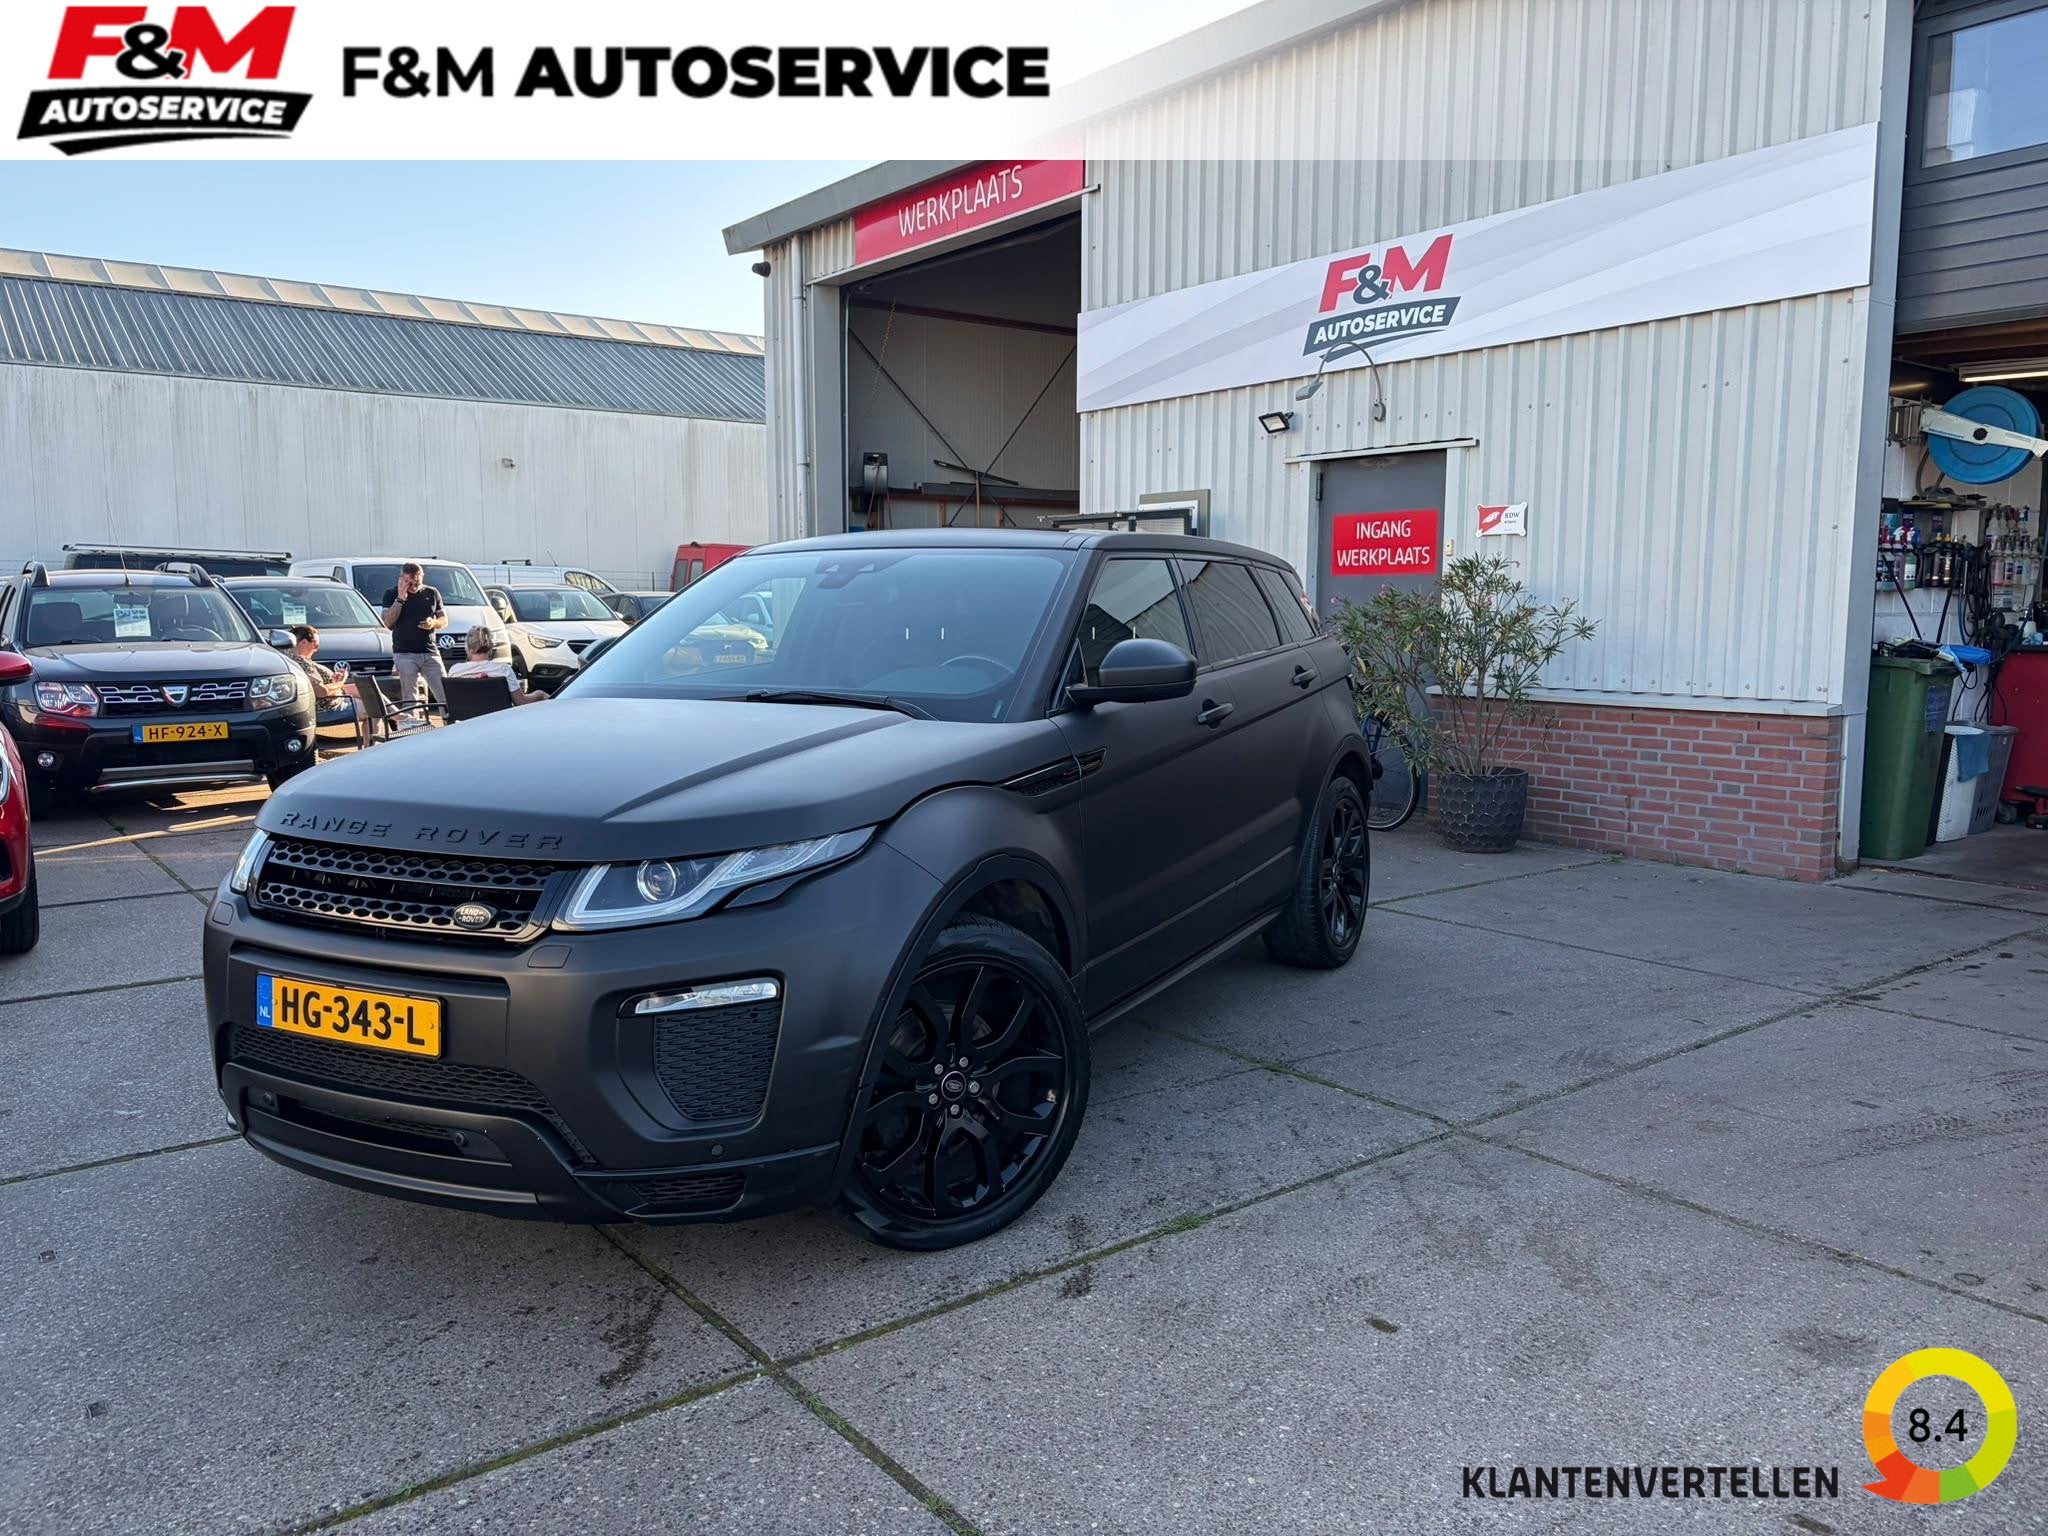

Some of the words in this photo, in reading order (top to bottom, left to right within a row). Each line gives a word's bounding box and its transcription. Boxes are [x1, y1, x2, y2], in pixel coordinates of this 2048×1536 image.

[898, 164, 1023, 237] WERKPLAATS
[1318, 233, 1454, 314] F&M
[1313, 304, 1447, 345] AUTOSERVICE
[1356, 519, 1412, 540] INGANG
[1336, 546, 1431, 567] WERKPLAATS
[149, 724, 222, 740] HF-924-X
[280, 811, 392, 838] RANGE
[415, 825, 564, 850] ROVER
[259, 1005, 271, 1018] NL
[282, 986, 425, 1046] HG-343-L
